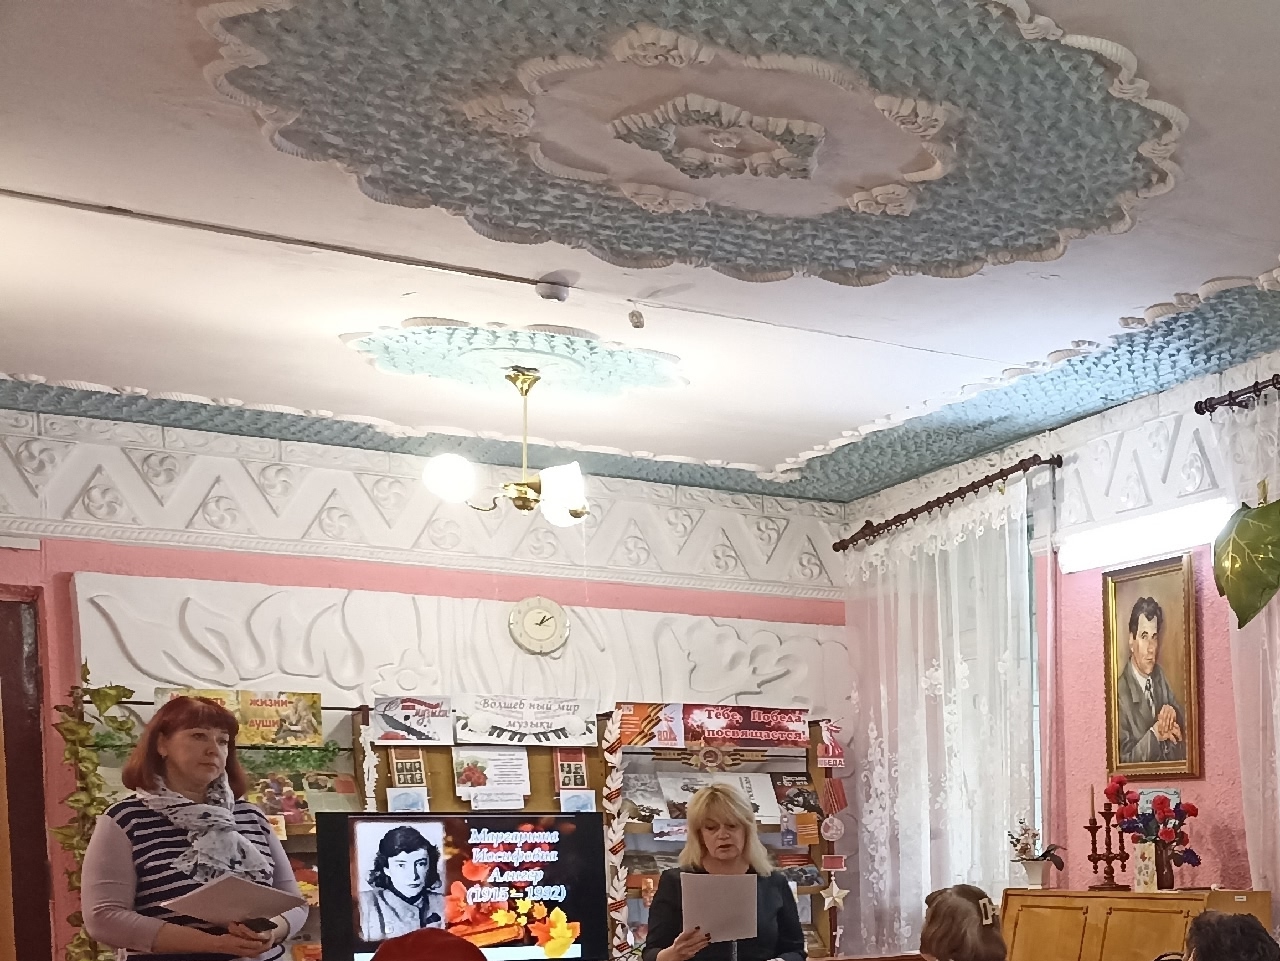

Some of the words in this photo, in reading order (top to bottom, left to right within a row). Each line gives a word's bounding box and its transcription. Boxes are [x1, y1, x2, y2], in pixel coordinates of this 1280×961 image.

[555, 703, 580, 713] мир
[704, 708, 743, 723] Тебе,
[750, 709, 806, 725] Победа,
[506, 719, 553, 730] музыки
[705, 727, 806, 742] посвящается!
[468, 828, 560, 848] Маргарита
[472, 847, 559, 867] Иосифовна
[487, 867, 544, 885] Алигер
[466, 884, 510, 905] (1915
[525, 885, 567, 903] 1992)
